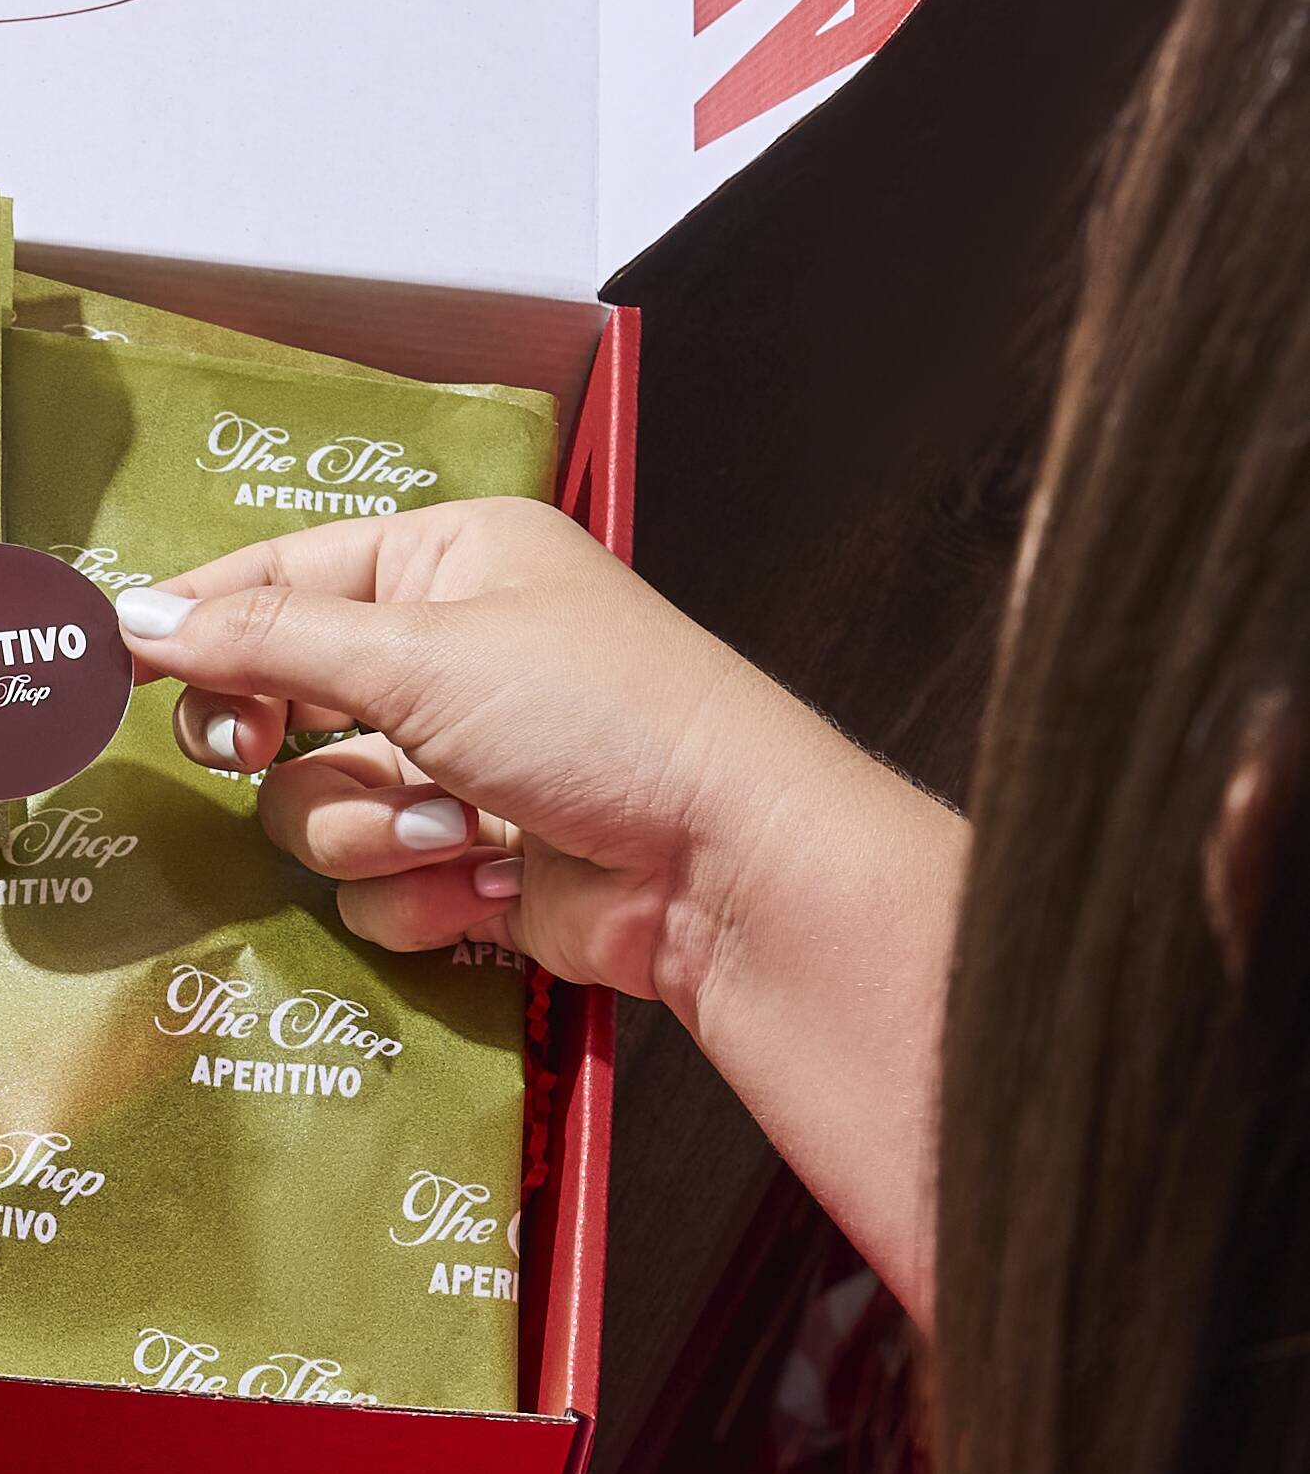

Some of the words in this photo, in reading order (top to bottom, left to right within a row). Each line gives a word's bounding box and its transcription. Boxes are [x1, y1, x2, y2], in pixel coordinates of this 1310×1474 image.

[196, 410, 295, 477] The
[307, 436, 438, 495] Shop
[3, 807, 138, 868] Shop
[155, 964, 258, 1039] The
[269, 988, 402, 1060] Shop
[191, 1054, 362, 1098] APERITIVO
[389, 1170, 497, 1246] The
